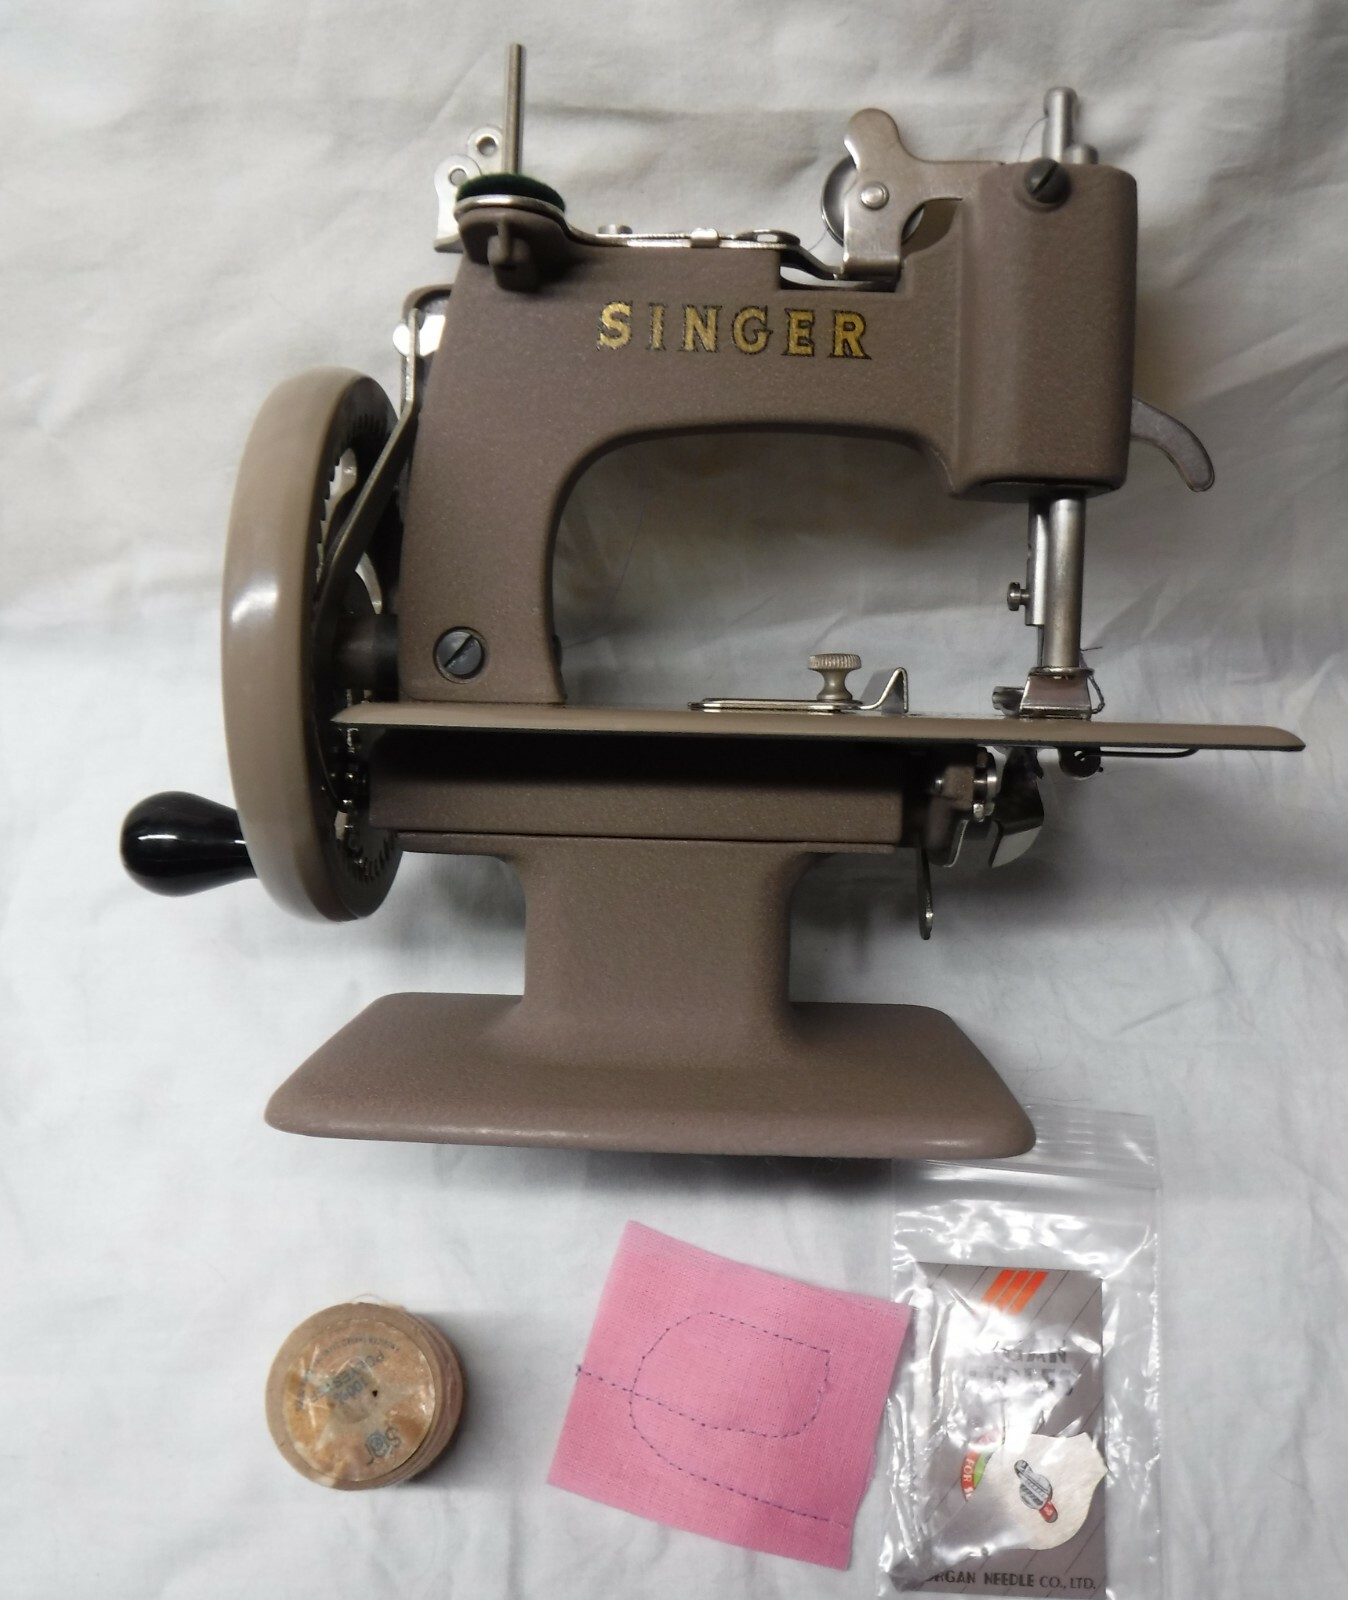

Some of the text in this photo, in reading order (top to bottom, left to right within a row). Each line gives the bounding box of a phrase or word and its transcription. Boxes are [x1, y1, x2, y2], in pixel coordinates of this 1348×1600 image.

[597, 300, 873, 360] SINGER
[962, 1458, 976, 1482] FOR
[984, 1572, 1034, 1587] NEEDLE
[1039, 1576, 1067, 1590] CO.,
[1070, 1577, 1096, 1590] LTD.
